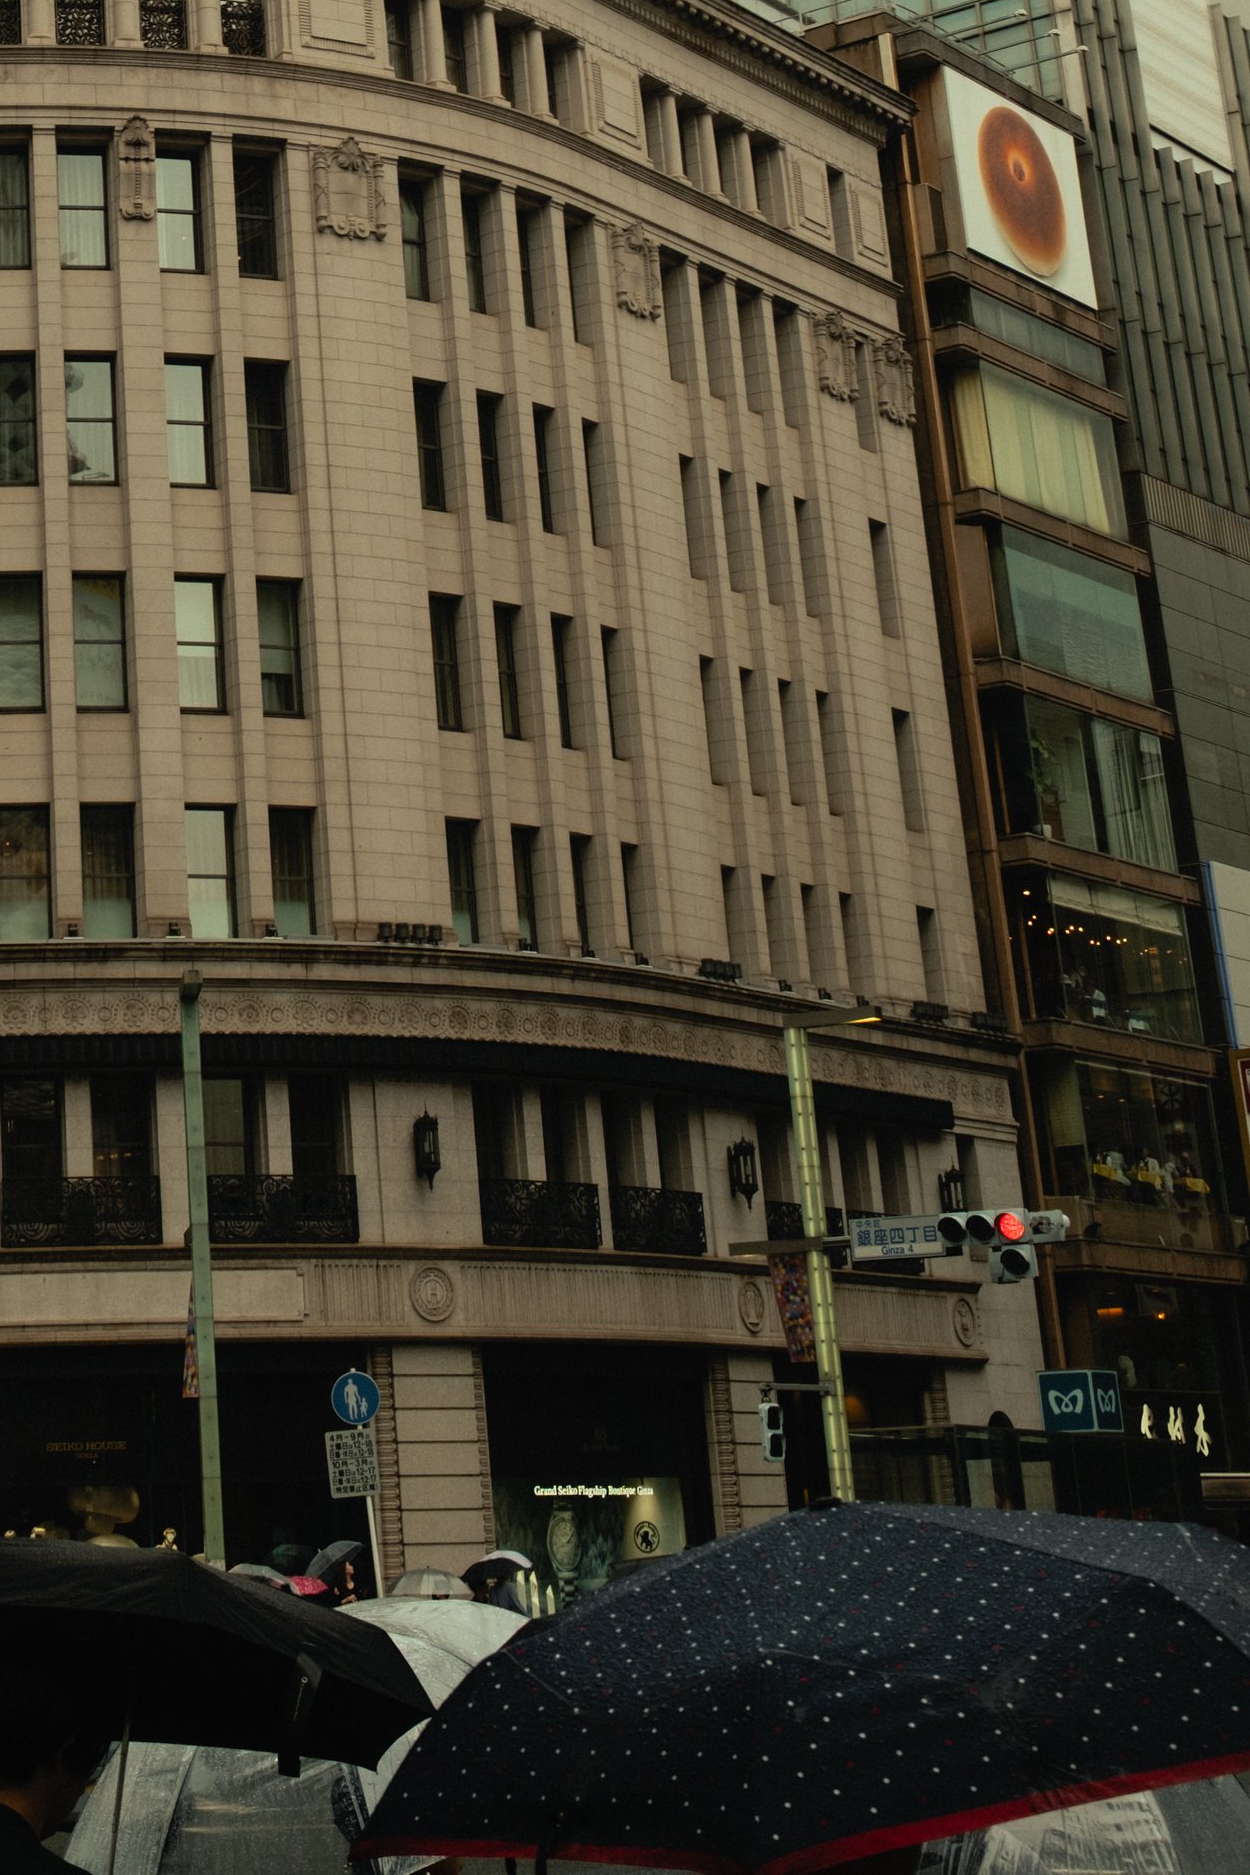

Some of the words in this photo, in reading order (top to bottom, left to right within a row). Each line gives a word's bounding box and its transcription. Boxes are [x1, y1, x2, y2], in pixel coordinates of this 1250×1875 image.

[855, 1219, 881, 1229] 中央区
[857, 1225, 937, 1246] 銀座四丁目
[881, 1246, 905, 1255] Ginza
[908, 1245, 914, 1254] 4
[46, 1442, 83, 1451] SEIKO
[85, 1441, 127, 1451] HOUSE
[534, 1485, 557, 1496] Grand
[558, 1485, 578, 1496] Seiko
[578, 1485, 607, 1499] Flagship
[608, 1485, 636, 1498] Boutique
[636, 1485, 654, 1496] Ginza
